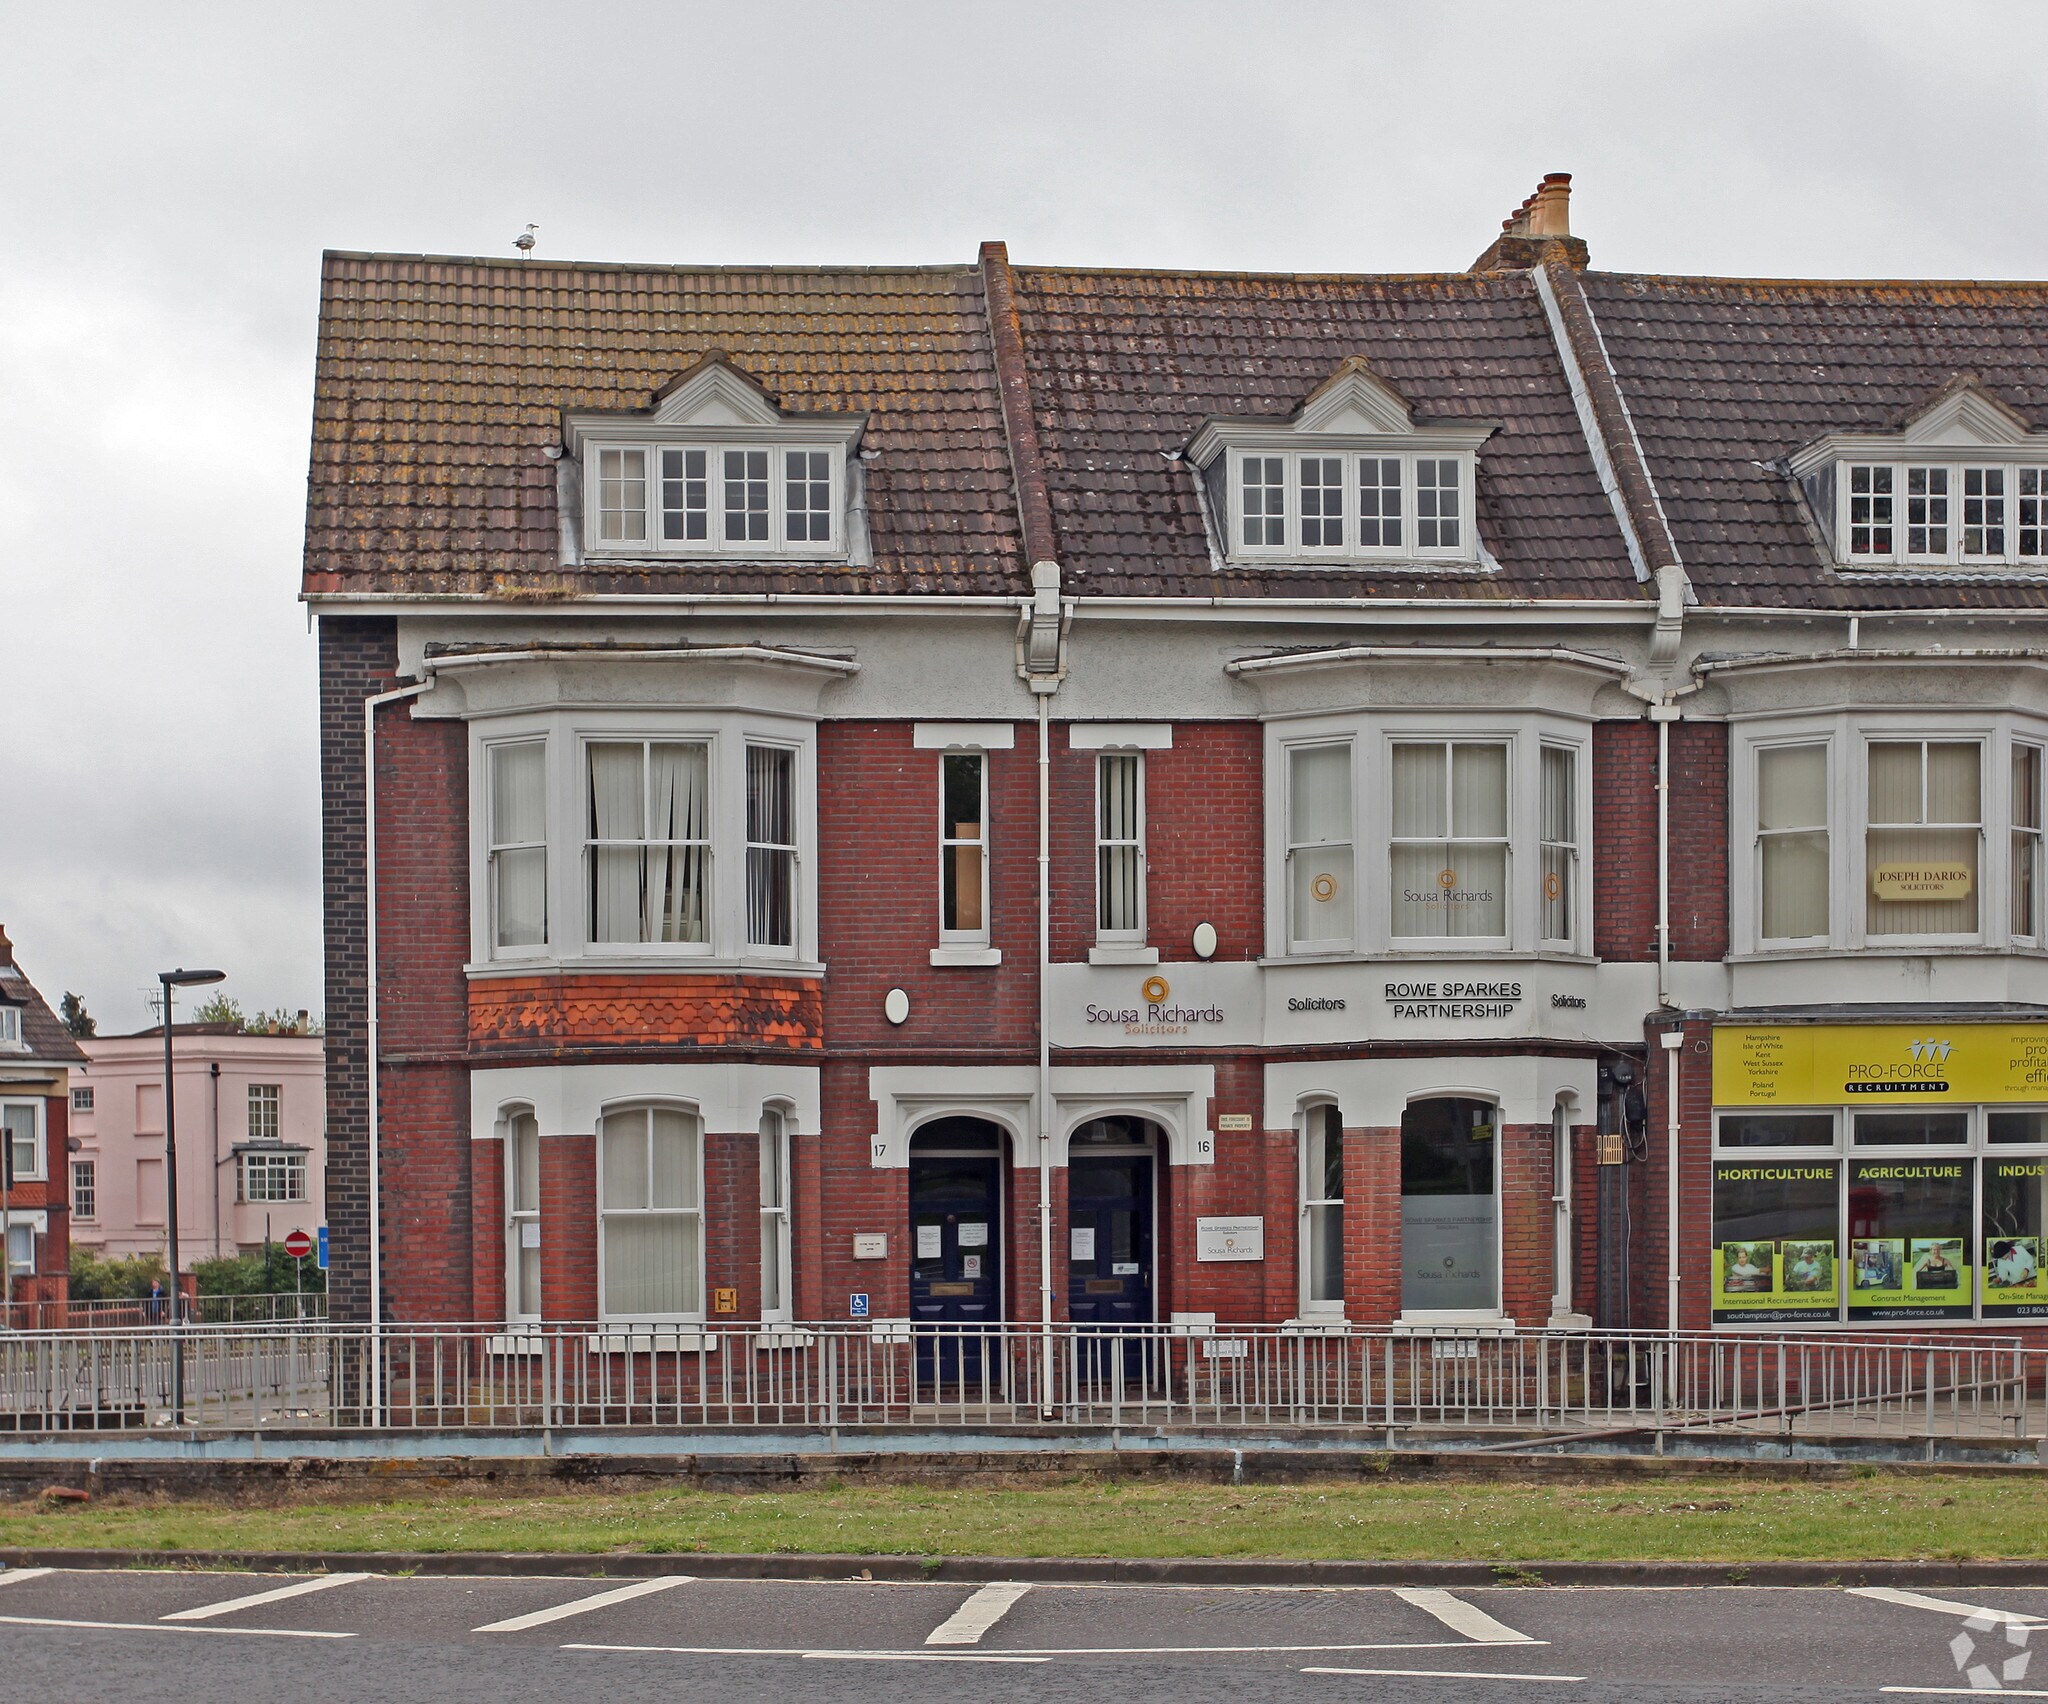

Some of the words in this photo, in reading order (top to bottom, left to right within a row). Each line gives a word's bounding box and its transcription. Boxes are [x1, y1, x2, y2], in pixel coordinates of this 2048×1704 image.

[1878, 871, 1920, 884] JOSEPH
[1924, 871, 1968, 881] DARIOS
[1900, 883, 1945, 891] SOLICITORS
[1403, 889, 1438, 902] Sousa
[1443, 889, 1493, 902] Richards
[1385, 983, 1437, 997] ROWE
[1443, 982, 1522, 996] SPARKES
[1288, 998, 1346, 1011] Solicitors
[1551, 993, 1587, 1009] Solicitors
[1086, 1003, 1139, 1023] Sousa
[1147, 1003, 1225, 1023] Richards
[1393, 1003, 1514, 1018] PARTNERSHIP
[1124, 1023, 1189, 1035] Solicitors
[1745, 1034, 1781, 1042] Hampshire
[2009, 1056, 2048, 1071] profita
[1848, 1063, 1945, 1079] PRO-FORCE
[2025, 1068, 2048, 1083] effi
[1752, 1081, 1774, 1089] Poland
[1848, 1083, 1945, 1092] RECRUITMENT
[1749, 1090, 1777, 1098] Portugal
[874, 1144, 887, 1157] 17
[1197, 1140, 1210, 1153] 16
[1717, 1168, 1834, 1181] HORTICULTURE
[1858, 1166, 1963, 1179] AGRICULTURE
[1207, 1246, 1226, 1255] Sousa
[1227, 1246, 1254, 1254] Richards
[1417, 1269, 1442, 1279] Sousa
[1722, 1297, 1766, 1305] International
[1767, 1297, 1809, 1305] Recruitment
[1810, 1296, 1835, 1304] Service
[1871, 1294, 1901, 1302] Contract
[1903, 1294, 1946, 1304] Management
[1998, 1292, 2024, 1300] On-Site
[2026, 1292, 2048, 1301] Manag
[1726, 1310, 1832, 1320] southampton@pro-force.co.uk
[1871, 1308, 1945, 1318] www.pro-force.co.uk
[2016, 1306, 2030, 1314] 023
